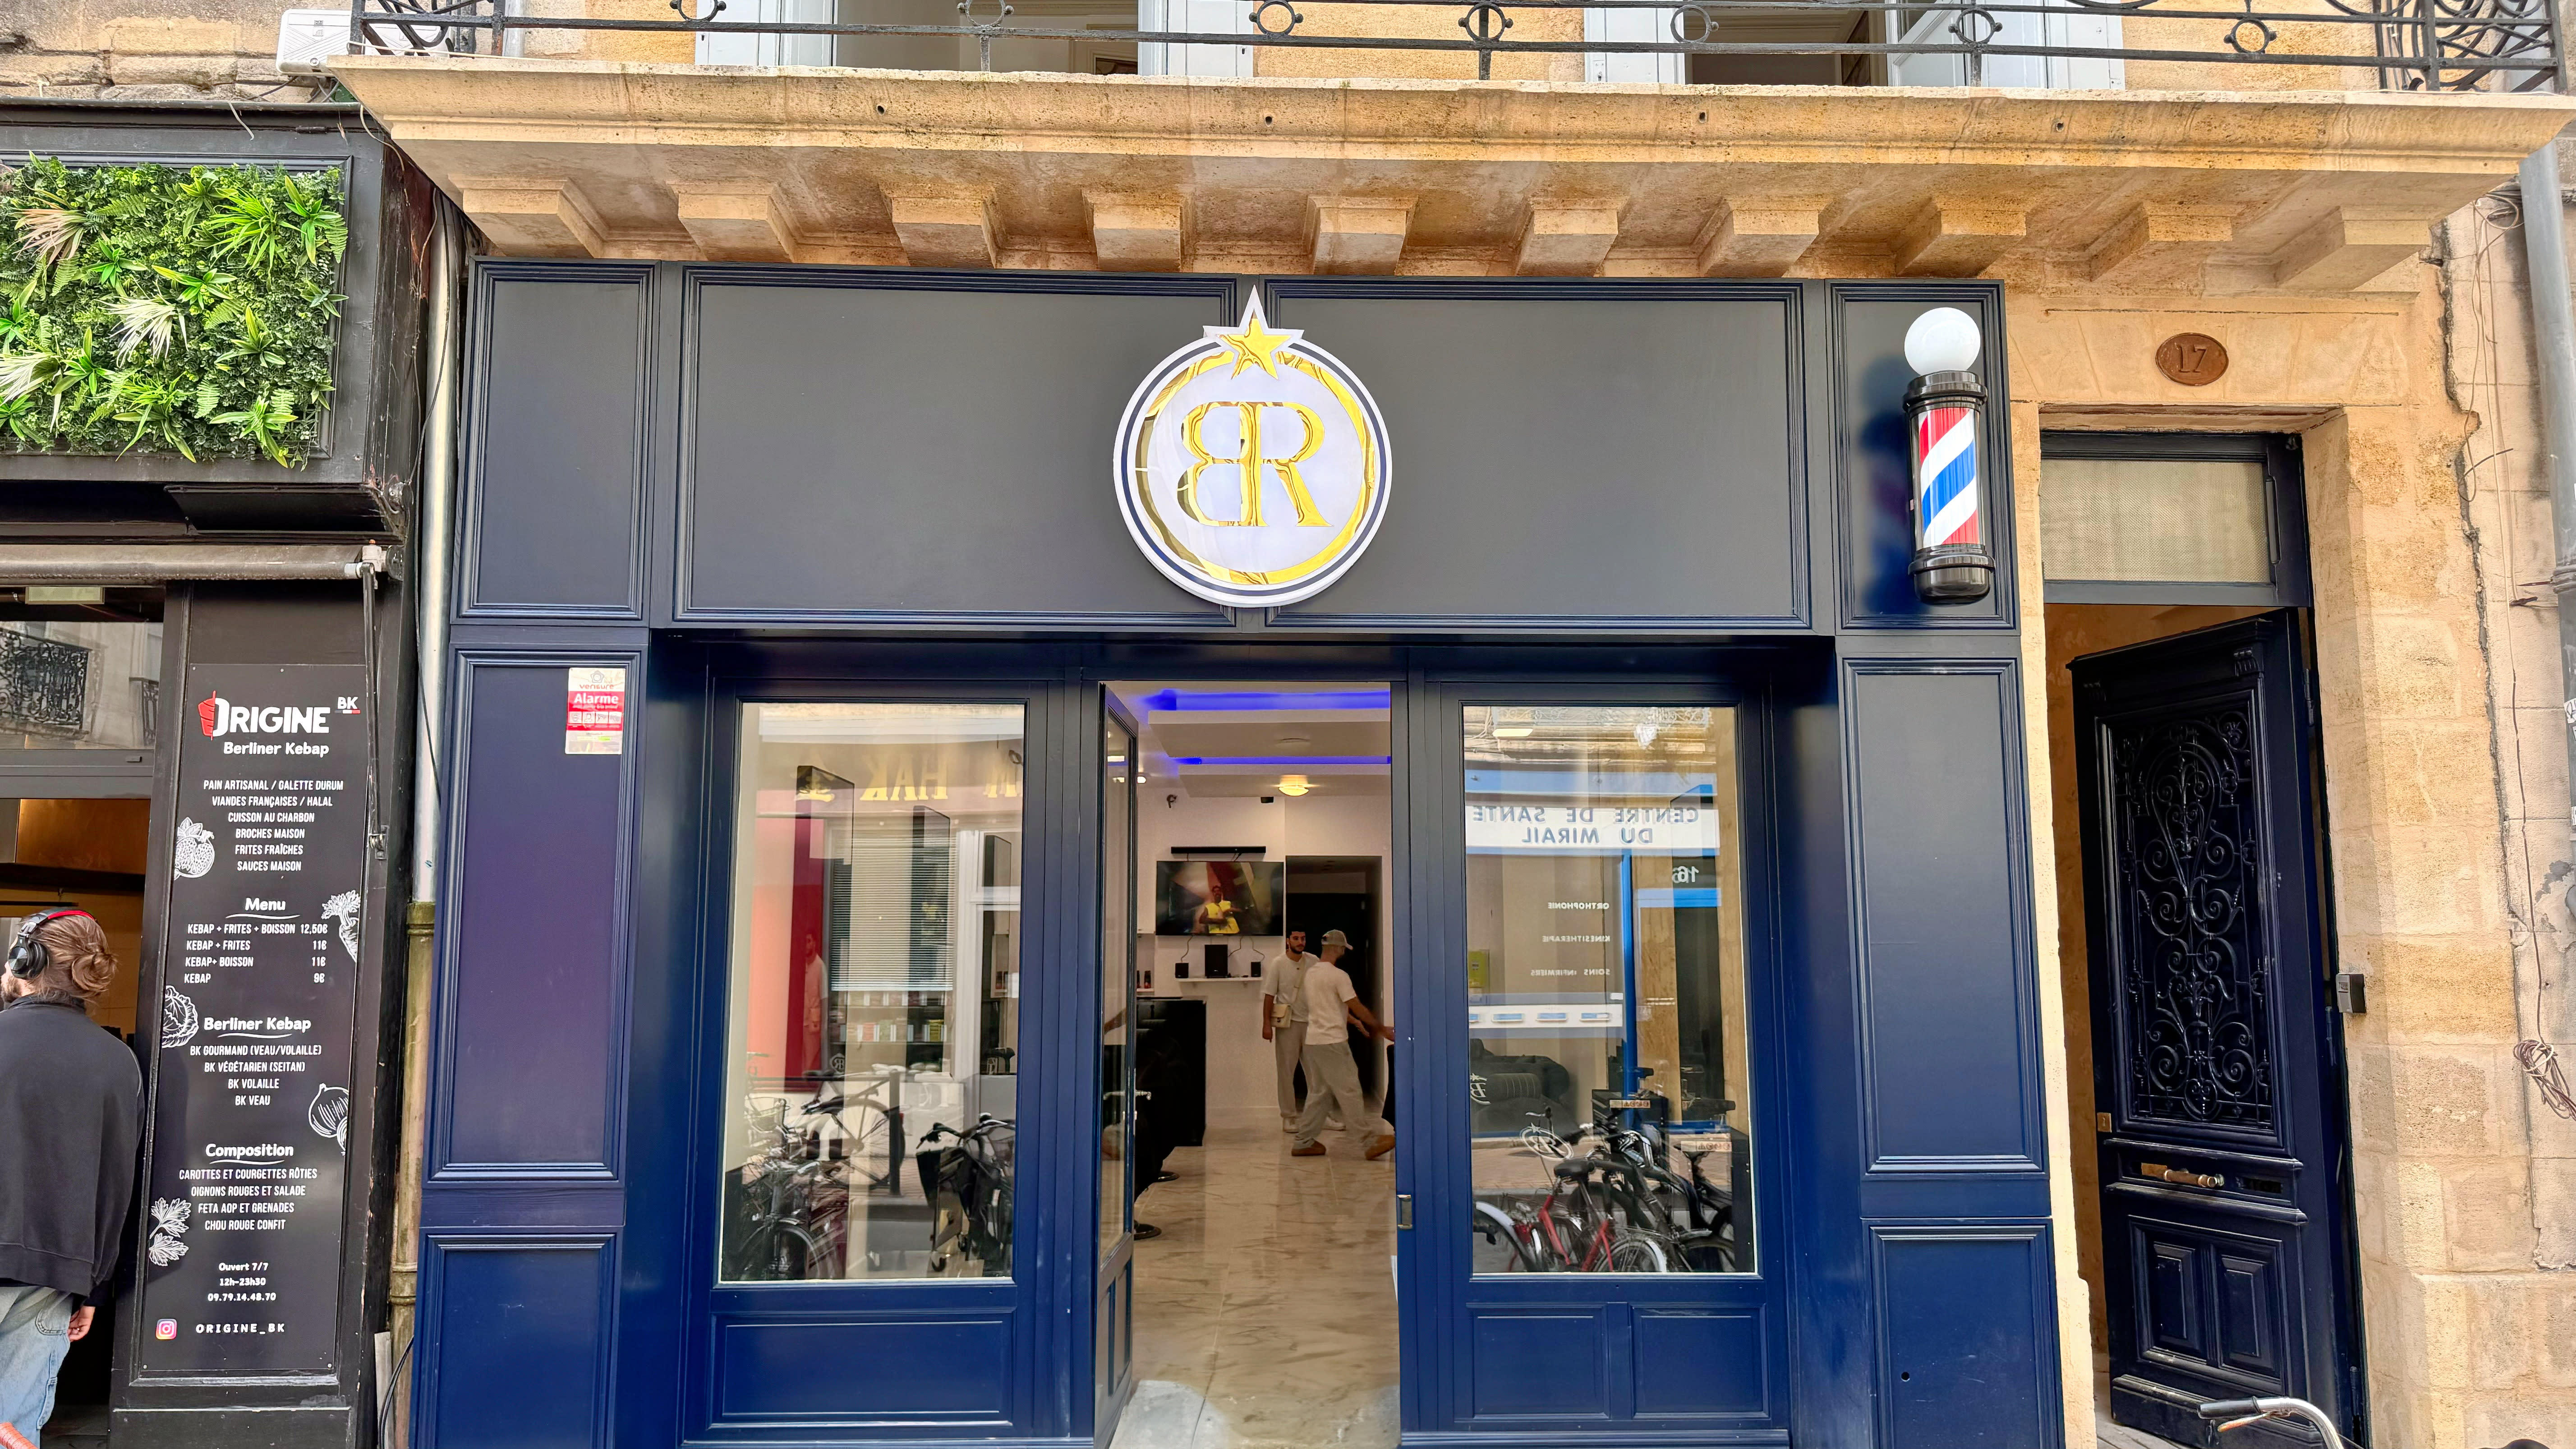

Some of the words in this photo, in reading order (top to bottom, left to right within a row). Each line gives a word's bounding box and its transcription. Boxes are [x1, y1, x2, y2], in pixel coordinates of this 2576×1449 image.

[2178, 344, 2208, 373] 17
[338, 697, 358, 709] BK
[574, 693, 619, 704] Alarme
[198, 697, 331, 737] ORIGINE
[224, 742, 281, 754] Berliner
[285, 742, 329, 758] Kebap
[204, 780, 222, 790] PAIN
[225, 780, 269, 790] ARTISANAL
[271, 780, 276, 790] /
[279, 780, 313, 790] GALETTE
[316, 781, 343, 790] DURUM
[212, 796, 246, 806] VIANDES
[248, 796, 297, 808] FRANÇAISES
[300, 797, 305, 806] /
[307, 796, 332, 806] HALAL
[228, 812, 262, 822] CUISSON
[264, 813, 275, 822] AU
[277, 813, 314, 822] CHARBON
[236, 828, 272, 838] BROCHES
[274, 828, 305, 838] MAISON
[235, 845, 262, 855] FRITES
[265, 843, 303, 855] FRAÎCHES
[237, 861, 268, 871] SAUCES
[271, 861, 301, 871] MAISON
[245, 898, 285, 911] Menu
[188, 924, 214, 934] KEBAP
[224, 924, 251, 934] FRITES
[262, 924, 295, 934] BOISSON
[187, 940, 213, 950] KEBAP
[223, 940, 250, 950] FRITES
[220, 957, 253, 966] BOISSON
[184, 973, 211, 983] KEBAP
[204, 1017, 263, 1030] Berliner
[267, 1017, 311, 1033] Kebap
[190, 1046, 201, 1055] BK
[203, 1045, 248, 1055] GOURMAND
[250, 1045, 321, 1055] (VEAU/VOLAILLE)
[204, 1063, 215, 1072] BK
[218, 1061, 267, 1072] VÉGÉTARIEN
[270, 1062, 305, 1072] (SEITAN)
[228, 1079, 239, 1089] BK
[242, 1079, 279, 1088] VOLAILLE
[235, 1095, 246, 1105] BK
[249, 1095, 270, 1105] VEAU
[206, 1144, 294, 1159] Composition
[179, 1169, 221, 1179] CAROTTES
[223, 1169, 233, 1179] ET
[235, 1169, 287, 1179] COURGETTES
[289, 1167, 317, 1178] RÔTIES
[191, 1186, 225, 1196] OIGNONS
[228, 1186, 259, 1196] ROUGES
[262, 1186, 272, 1196] ET
[274, 1186, 306, 1196] SALADE
[198, 1203, 218, 1213] FETA
[221, 1203, 237, 1213] AOP
[239, 1203, 250, 1213] ET
[252, 1202, 294, 1213] GRENADES
[205, 1220, 226, 1230] CHOU
[229, 1220, 255, 1230] ROUGE
[258, 1219, 286, 1229] CONFIT
[219, 1263, 249, 1271] Ouvert
[252, 1262, 268, 1270] 7/7
[220, 1277, 266, 1286] 12h-23h30
[207, 1293, 276, 1301] 09.79.14.48.70
[196, 1323, 284, 1334] ORIGINE_BK
